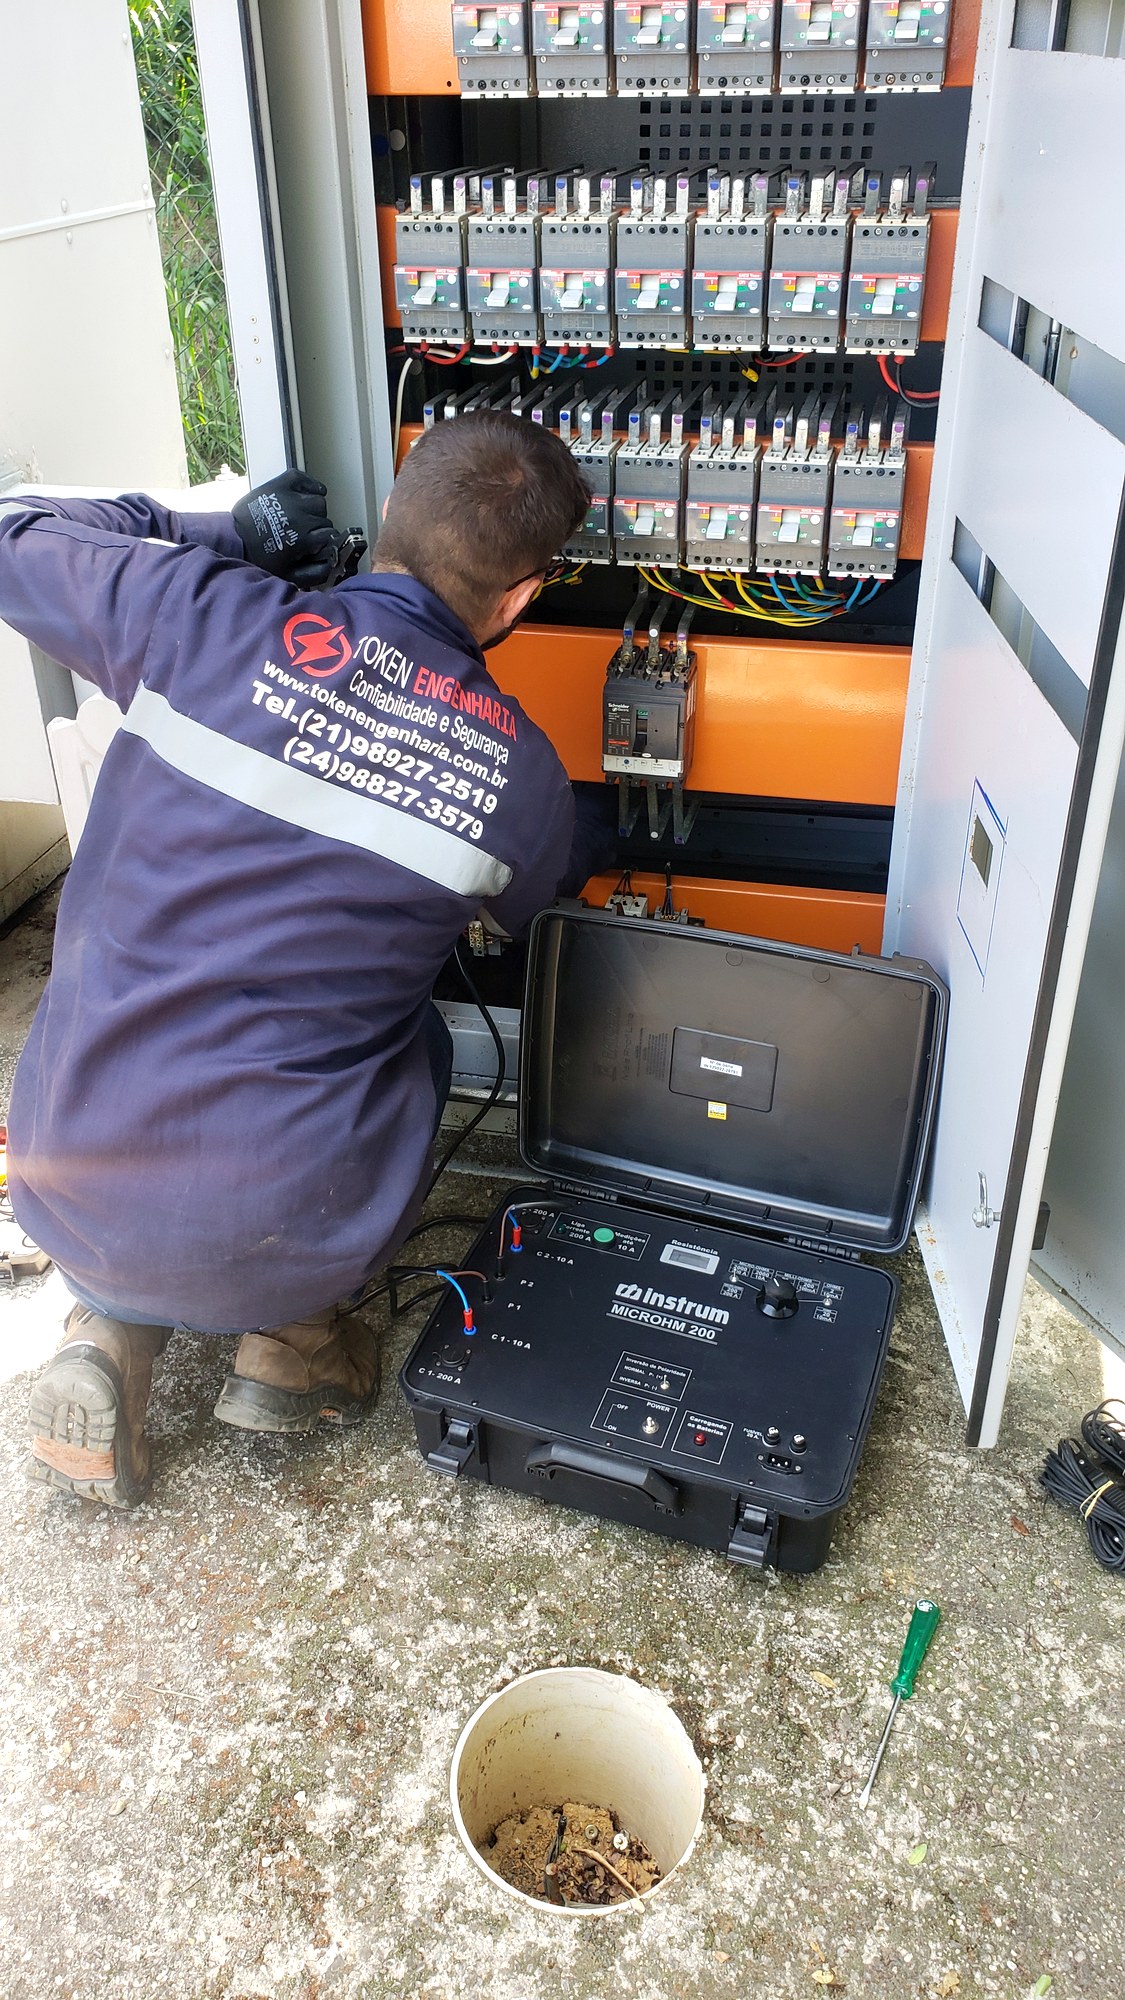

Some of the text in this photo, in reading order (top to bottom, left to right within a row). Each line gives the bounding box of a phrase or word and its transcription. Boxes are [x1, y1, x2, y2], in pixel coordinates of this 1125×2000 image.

[269, 493, 289, 528] VOLK
[414, 666, 517, 742] ENGENHARIA
[262, 660, 508, 790] www.tokenengenharia.com.br
[350, 670, 510, 765] Confiabilidade e Segurança
[252, 680, 498, 815] Tel.(21)98927-2519
[284, 736, 484, 840] (24)98827-3579
[615, 1232, 645, 1243] Medições
[671, 1239, 718, 1255] Resistência
[610, 1304, 716, 1340] MICROHM 200
[624, 1366, 645, 1374] NORMAL
[626, 1357, 649, 1367] Inversão
[657, 1366, 686, 1377] Polaridade
[436, 1372, 453, 1382] 200
[619, 1376, 641, 1385] INVERSA
[646, 1402, 670, 1412] POWER
[690, 1416, 727, 1430] Carregando
[696, 1424, 724, 1436] Baterias
